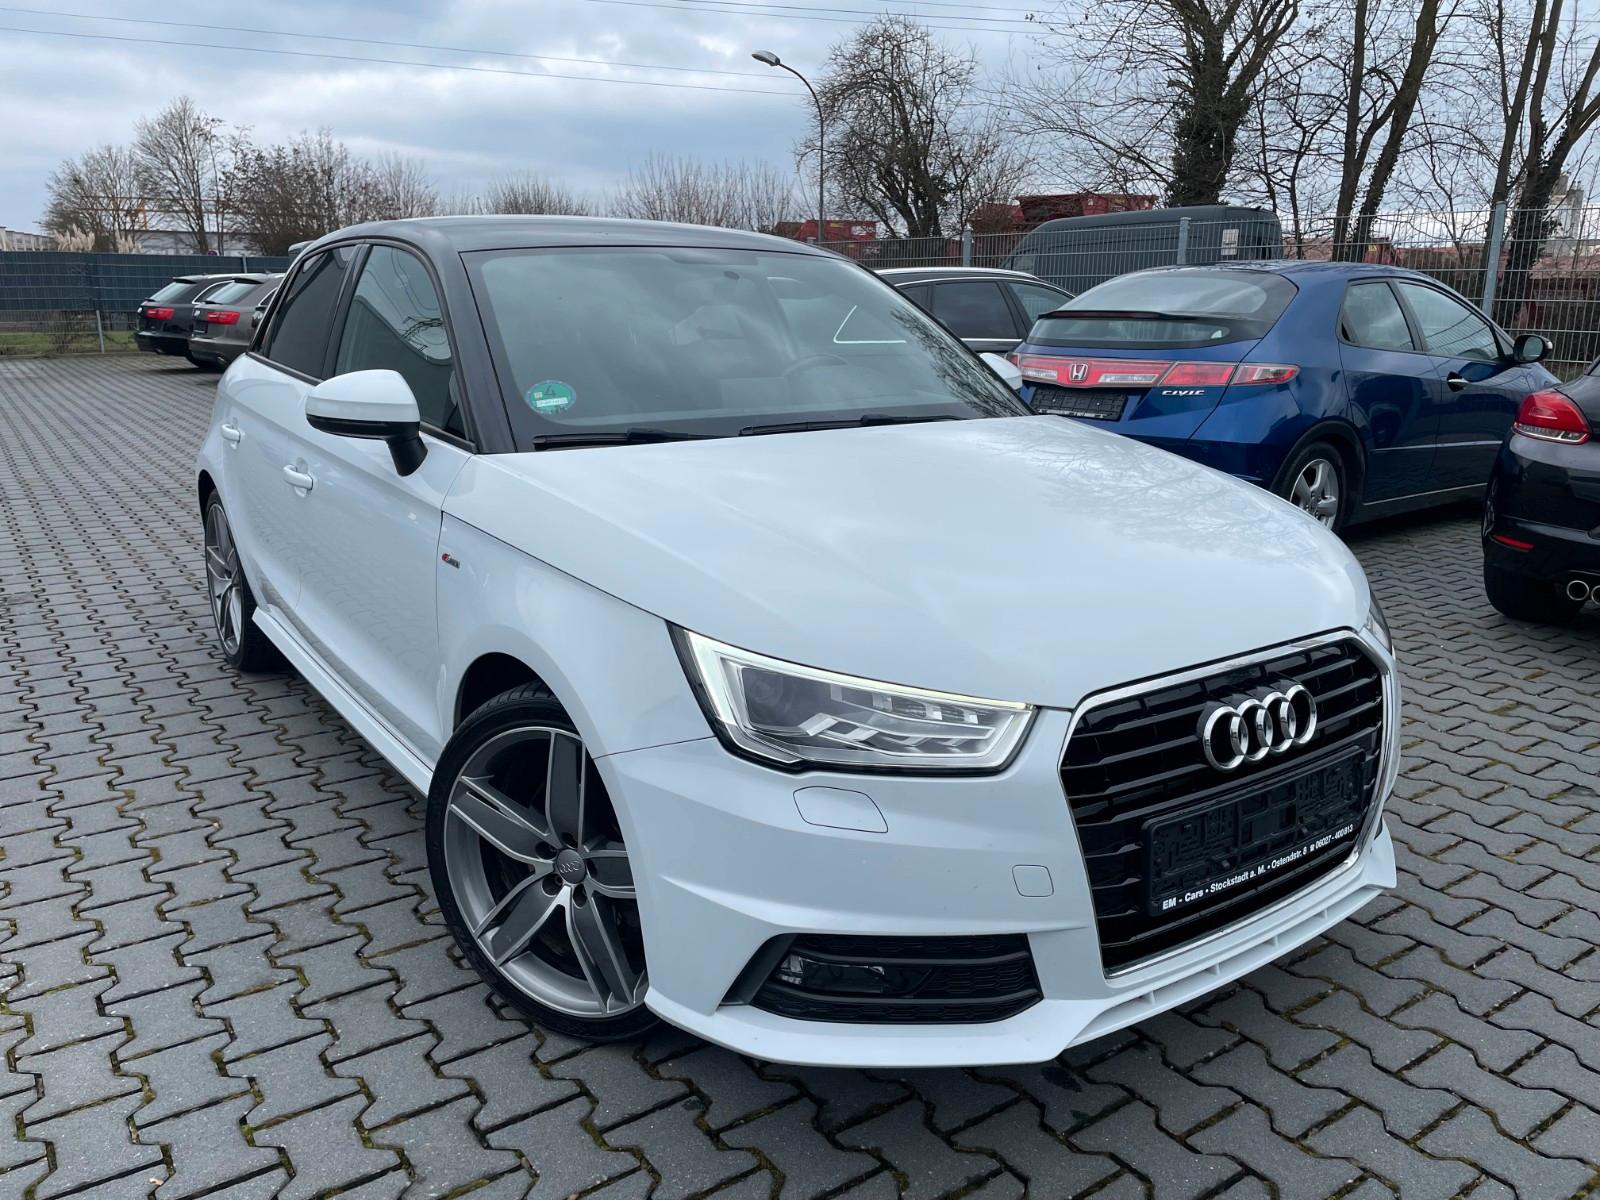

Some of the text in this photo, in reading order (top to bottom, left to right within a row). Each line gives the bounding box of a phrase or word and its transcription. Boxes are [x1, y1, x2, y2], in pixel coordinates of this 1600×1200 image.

[1162, 897, 1177, 910] EM
[1184, 889, 1204, 902] Cars
[1210, 871, 1249, 893] Stockstadt
